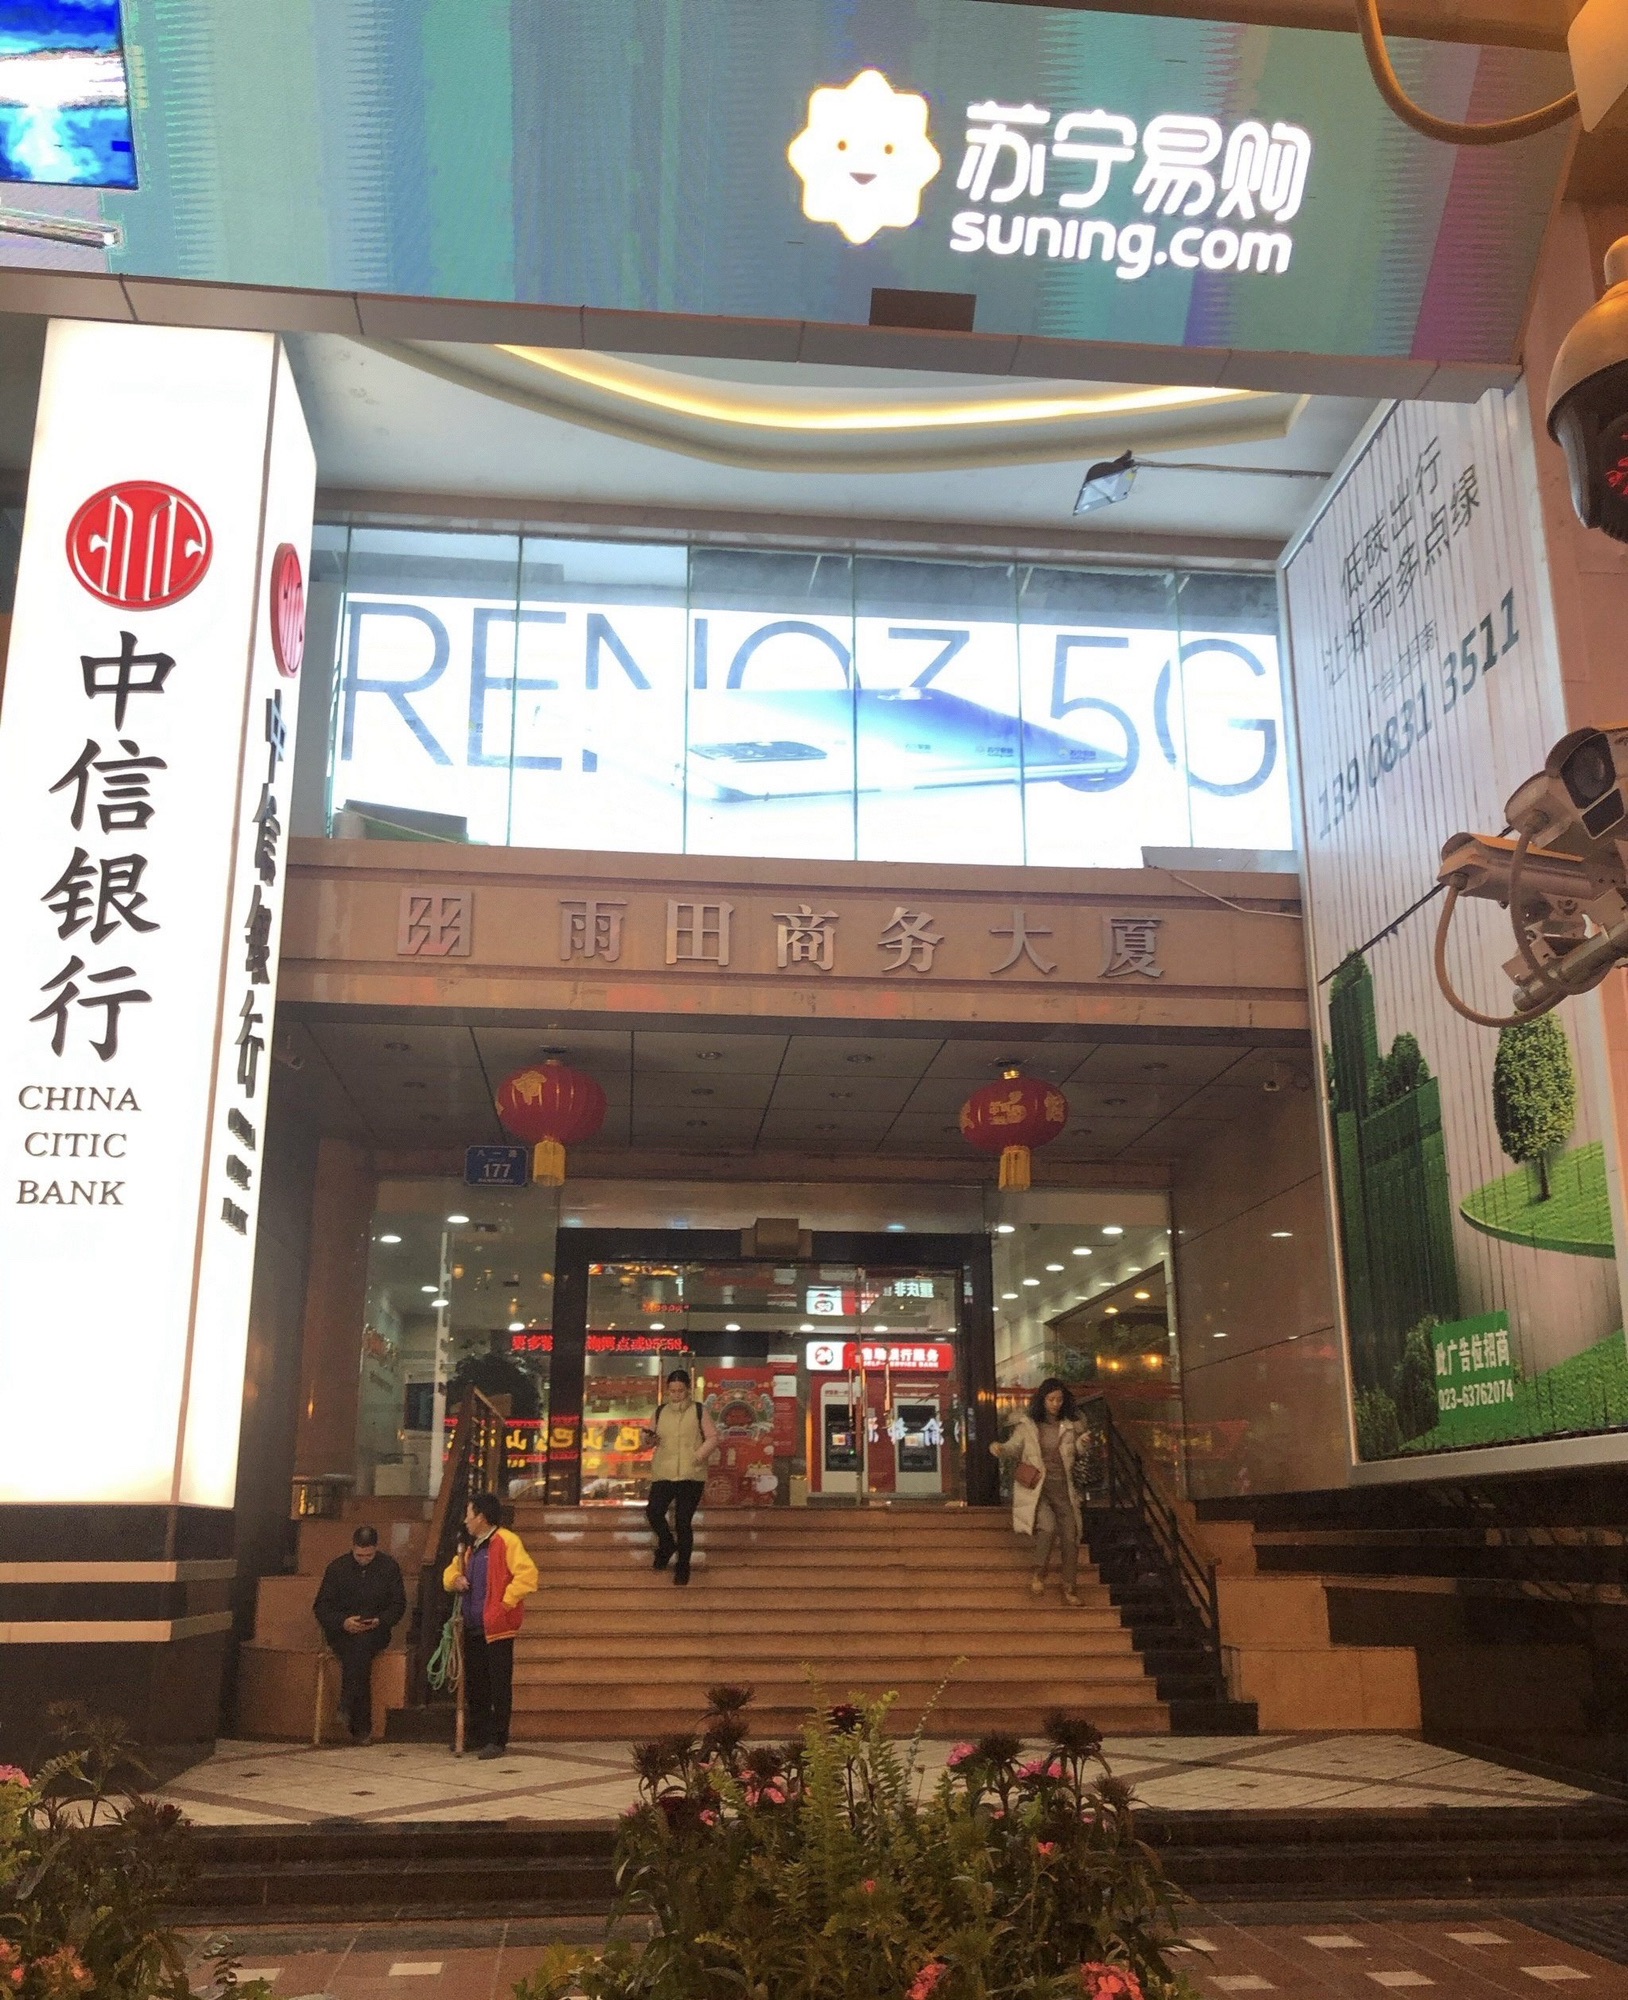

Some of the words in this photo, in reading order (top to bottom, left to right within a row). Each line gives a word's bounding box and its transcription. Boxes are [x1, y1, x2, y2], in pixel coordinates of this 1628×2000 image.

[956, 100, 1311, 222] 苏宁易购
[949, 211, 1293, 280] suning.com
[1341, 435, 1440, 605] 低碳出行
[1050, 634, 1277, 797] 5G
[1366, 681, 1432, 788] 0831
[1443, 586, 1520, 715] 3511
[29, 630, 177, 1062] 中信银行
[559, 899, 1164, 978] 雨田商务大厦
[18, 1085, 141, 1111] CHINA
[24, 1131, 127, 1158] CITIC
[483, 1163, 511, 1178] 177
[16, 1179, 125, 1205] BANK
[1438, 1379, 1514, 1411] 023-63762074
